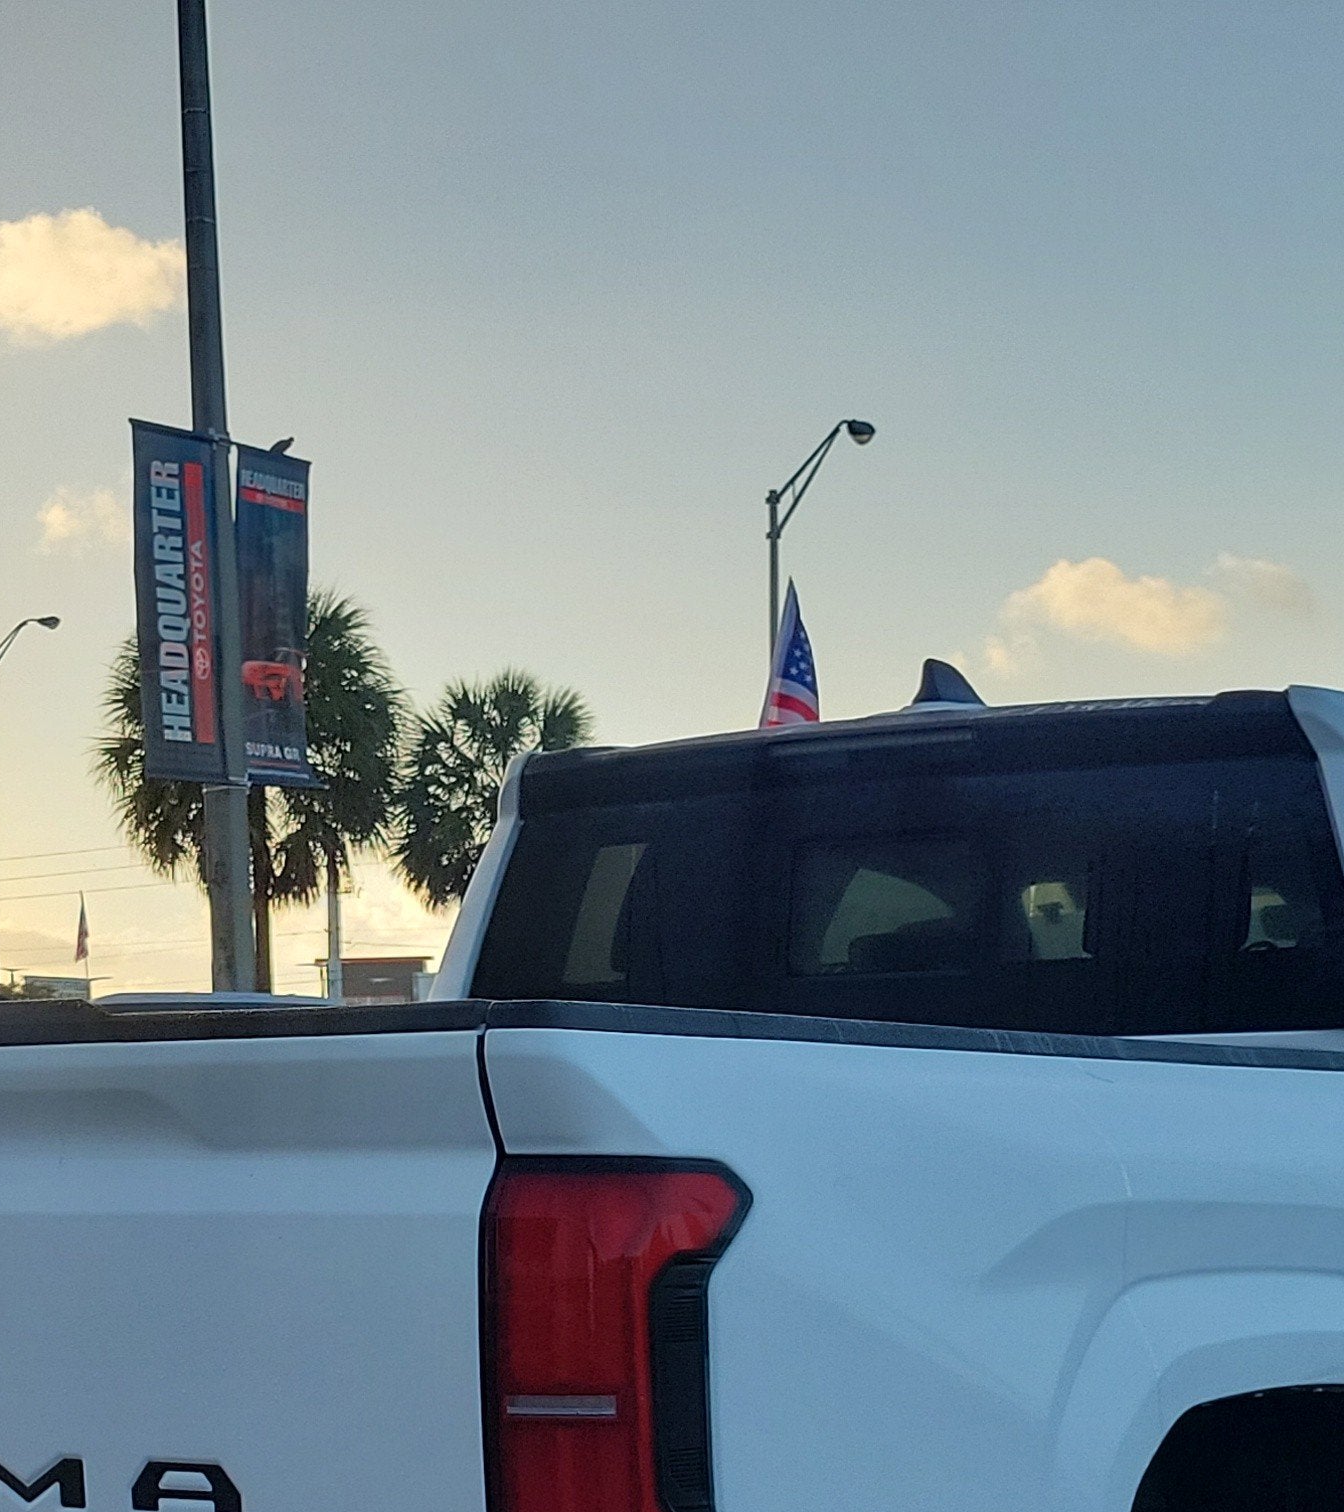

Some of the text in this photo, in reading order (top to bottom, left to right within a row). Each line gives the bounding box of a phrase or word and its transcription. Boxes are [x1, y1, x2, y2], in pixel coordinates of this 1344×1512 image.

[150, 460, 193, 742] HEADQUARTER
[189, 539, 207, 642] TOYOTA
[245, 742, 283, 759] SUPRA
